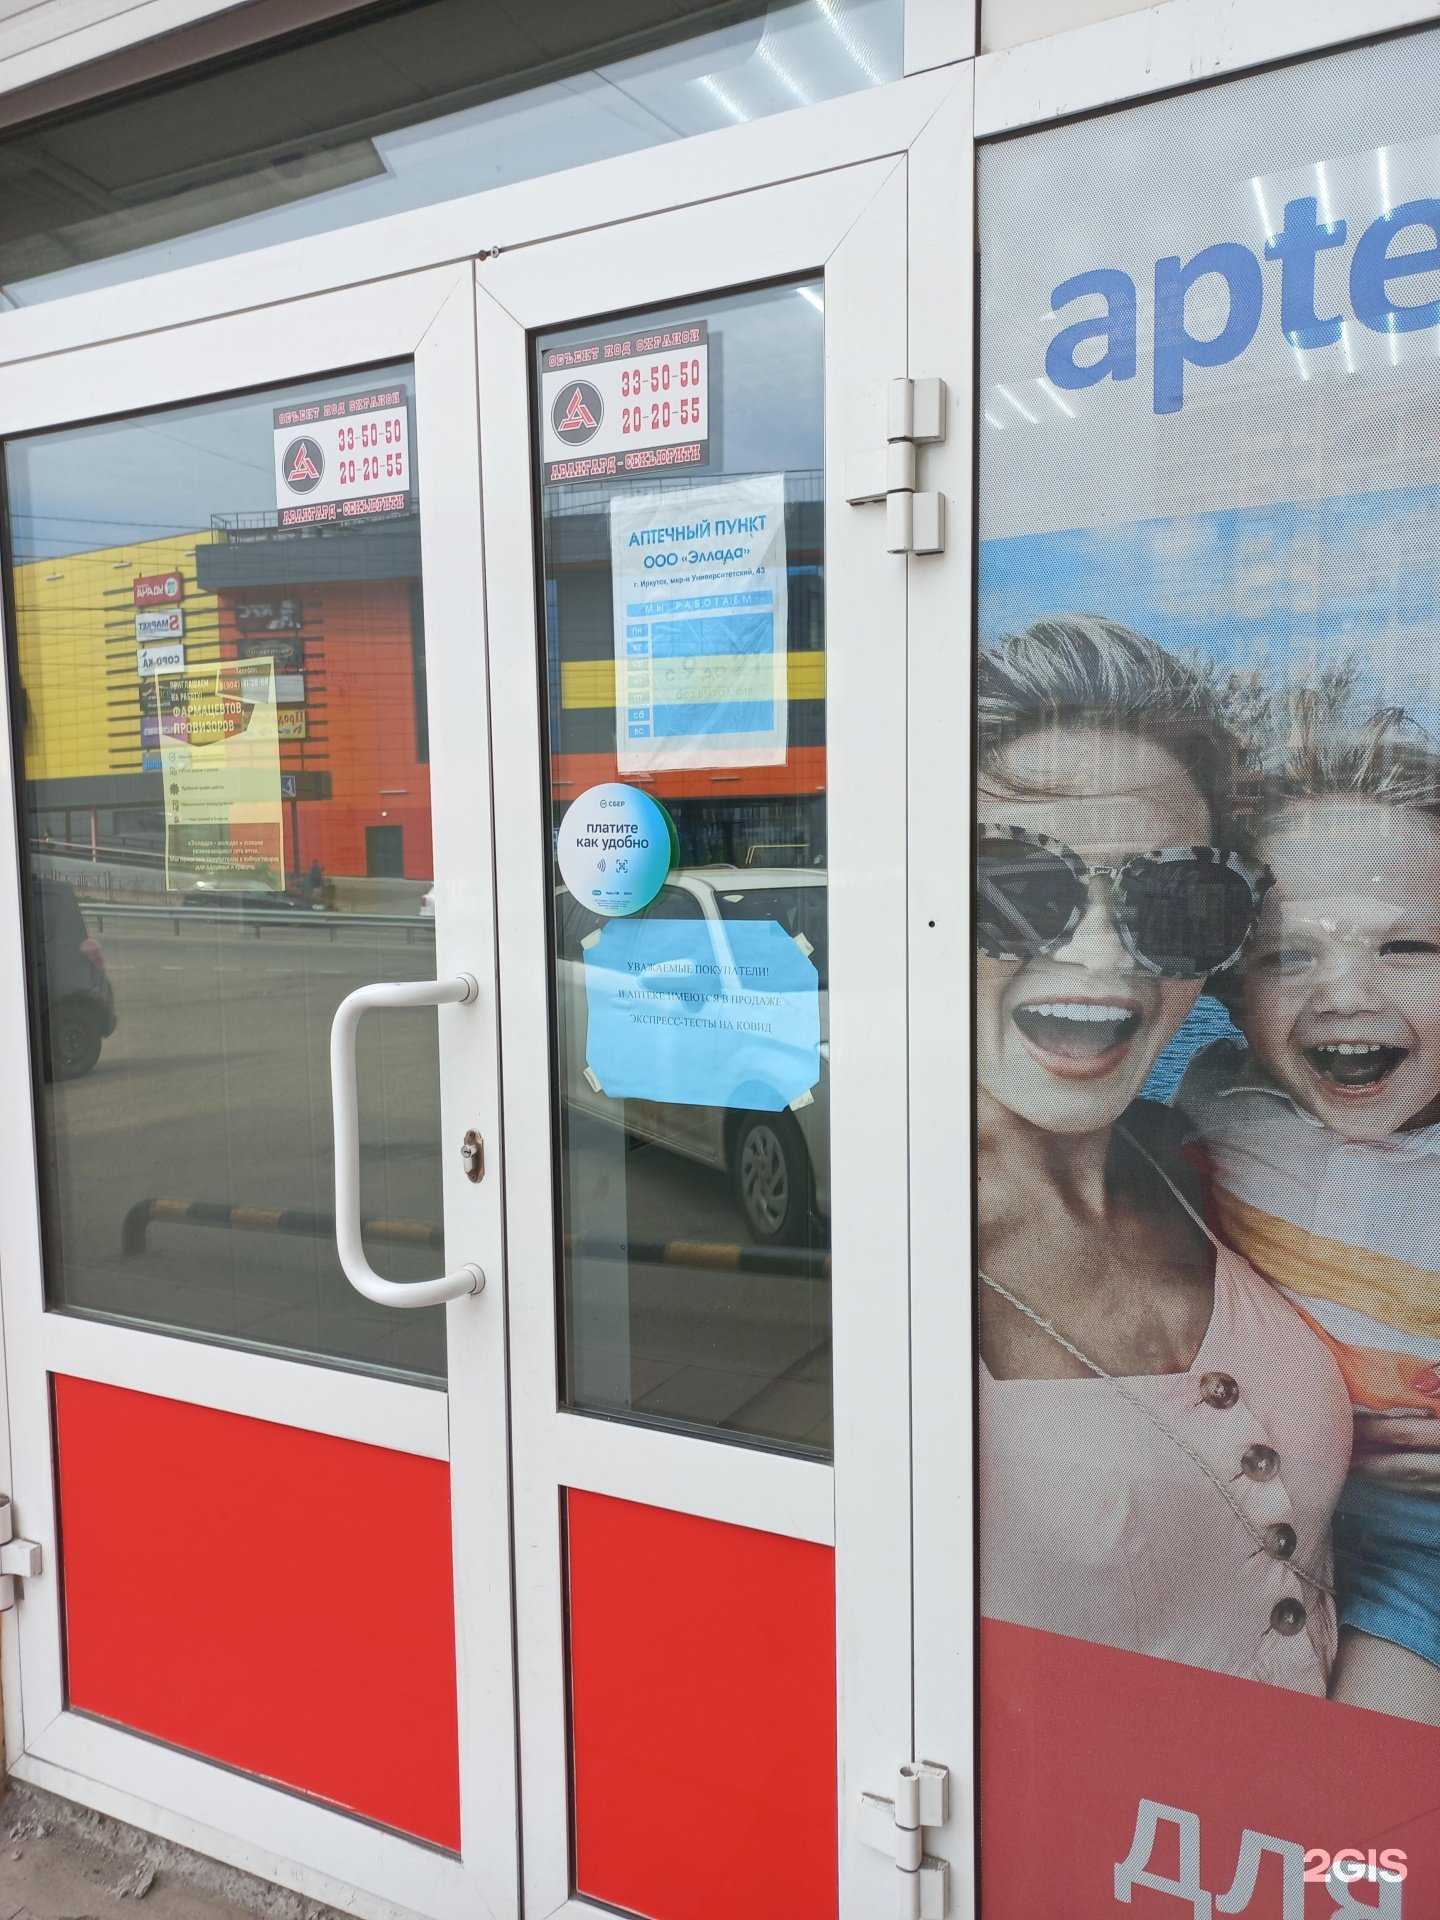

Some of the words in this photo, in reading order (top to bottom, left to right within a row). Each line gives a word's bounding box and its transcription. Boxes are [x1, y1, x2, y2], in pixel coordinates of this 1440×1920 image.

[548, 348, 599, 367] ОБЪЕКТ
[604, 342, 631, 358] ПОД
[636, 329, 700, 353] ОХРАНОЙ
[621, 359, 700, 397] 33-50-50
[622, 397, 700, 434] 20-20-55
[338, 419, 401, 452] 33-50-50
[339, 452, 402, 485] 20-20-55
[629, 520, 711, 547] АПТЕЧНЫЙ
[715, 515, 767, 537] ПУНКТ
[643, 552, 679, 569] ООО
[682, 547, 751, 566] «Эллада»
[172, 701, 245, 718] ФАРМАЦЕВТОВ,
[174, 719, 235, 735] ПРОВИЗОРОВ
[586, 823, 639, 834] платите
[576, 838, 599, 848] как
[602, 835, 649, 851] удобно
[627, 961, 693, 974] УВАЖАЕМЫЕ
[695, 964, 769, 977] ПОКУПАТЕЛИ!
[630, 1014, 718, 1029] ЭКСПРЕСС-ТЕСТЫ
[720, 1019, 734, 1030] НА
[736, 1020, 773, 1033] КОВИД
